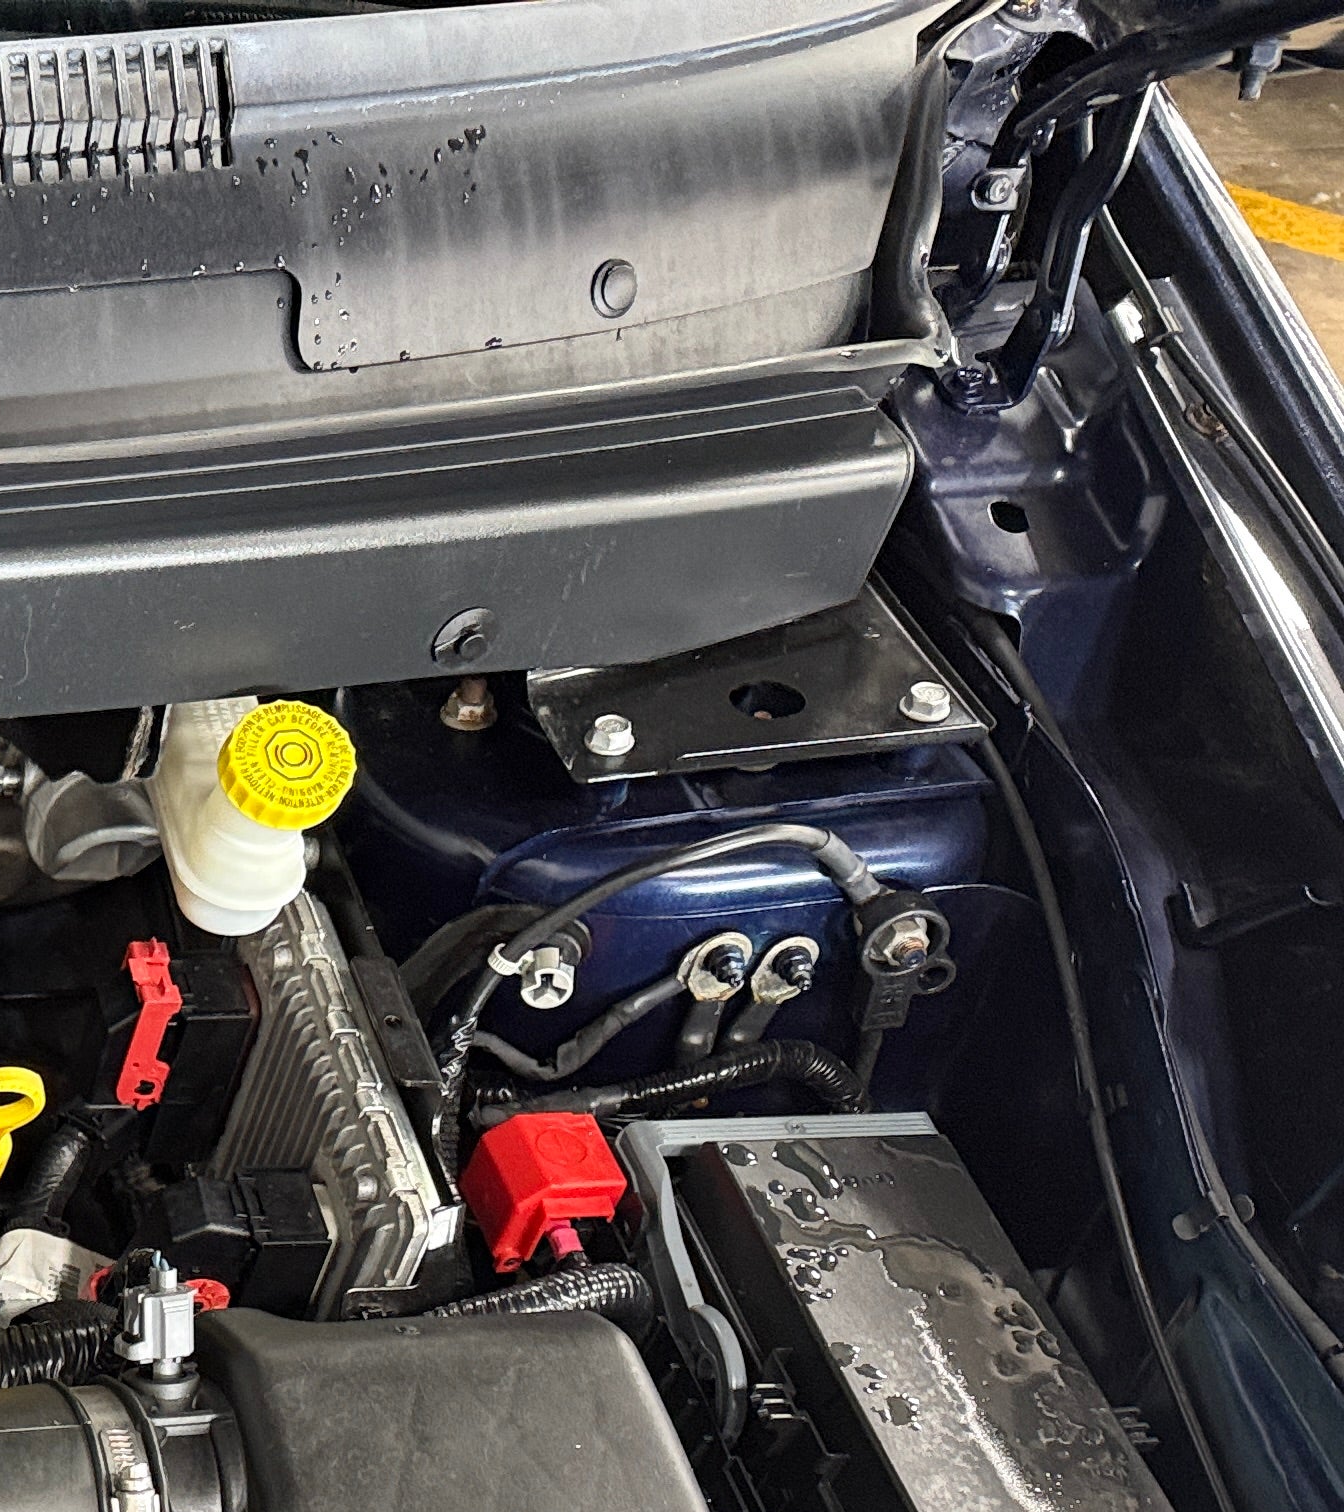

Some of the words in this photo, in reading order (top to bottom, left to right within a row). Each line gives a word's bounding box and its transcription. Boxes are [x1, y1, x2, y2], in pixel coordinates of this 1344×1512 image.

[263, 704, 322, 720] REMPLISSAGE
[247, 725, 265, 757] FILLER
[267, 715, 287, 727] CAP
[291, 715, 329, 738] BEFORE
